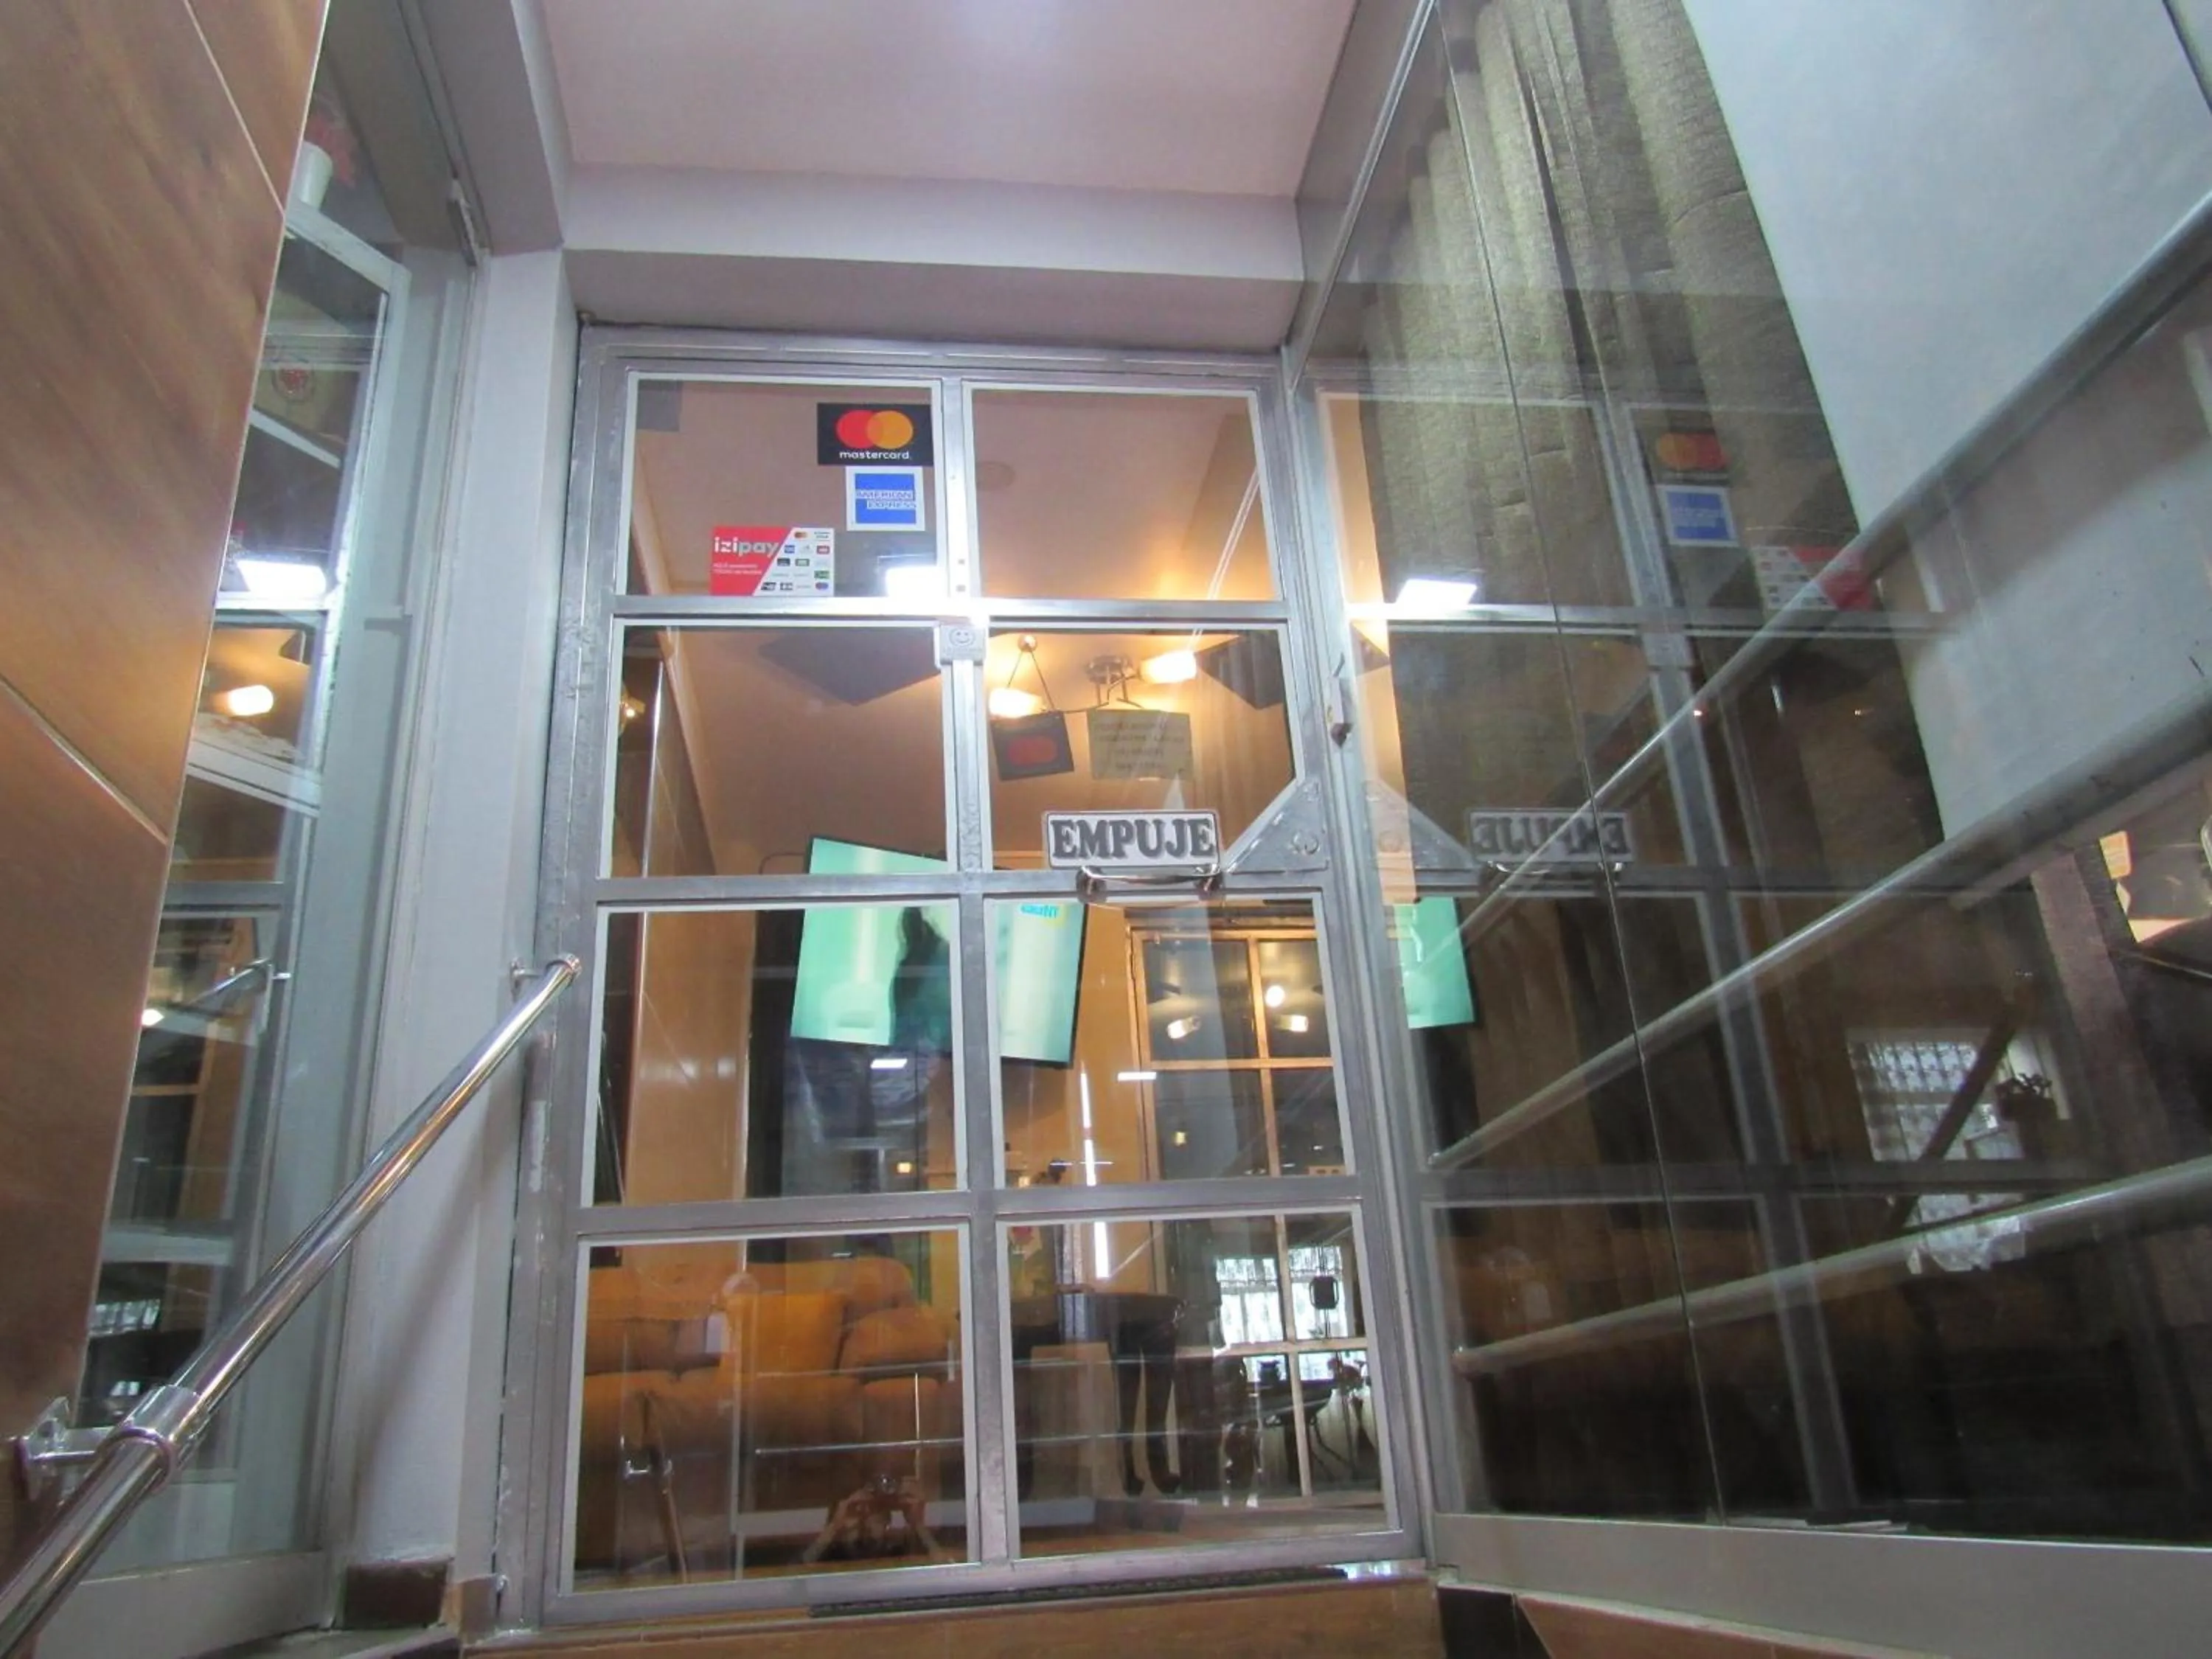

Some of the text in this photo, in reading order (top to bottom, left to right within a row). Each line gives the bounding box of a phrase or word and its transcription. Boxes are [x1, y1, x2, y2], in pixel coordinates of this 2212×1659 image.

[839, 451, 910, 460] mastercard
[714, 538, 779, 557] izipay
[1050, 818, 1216, 860] EMPUJE
